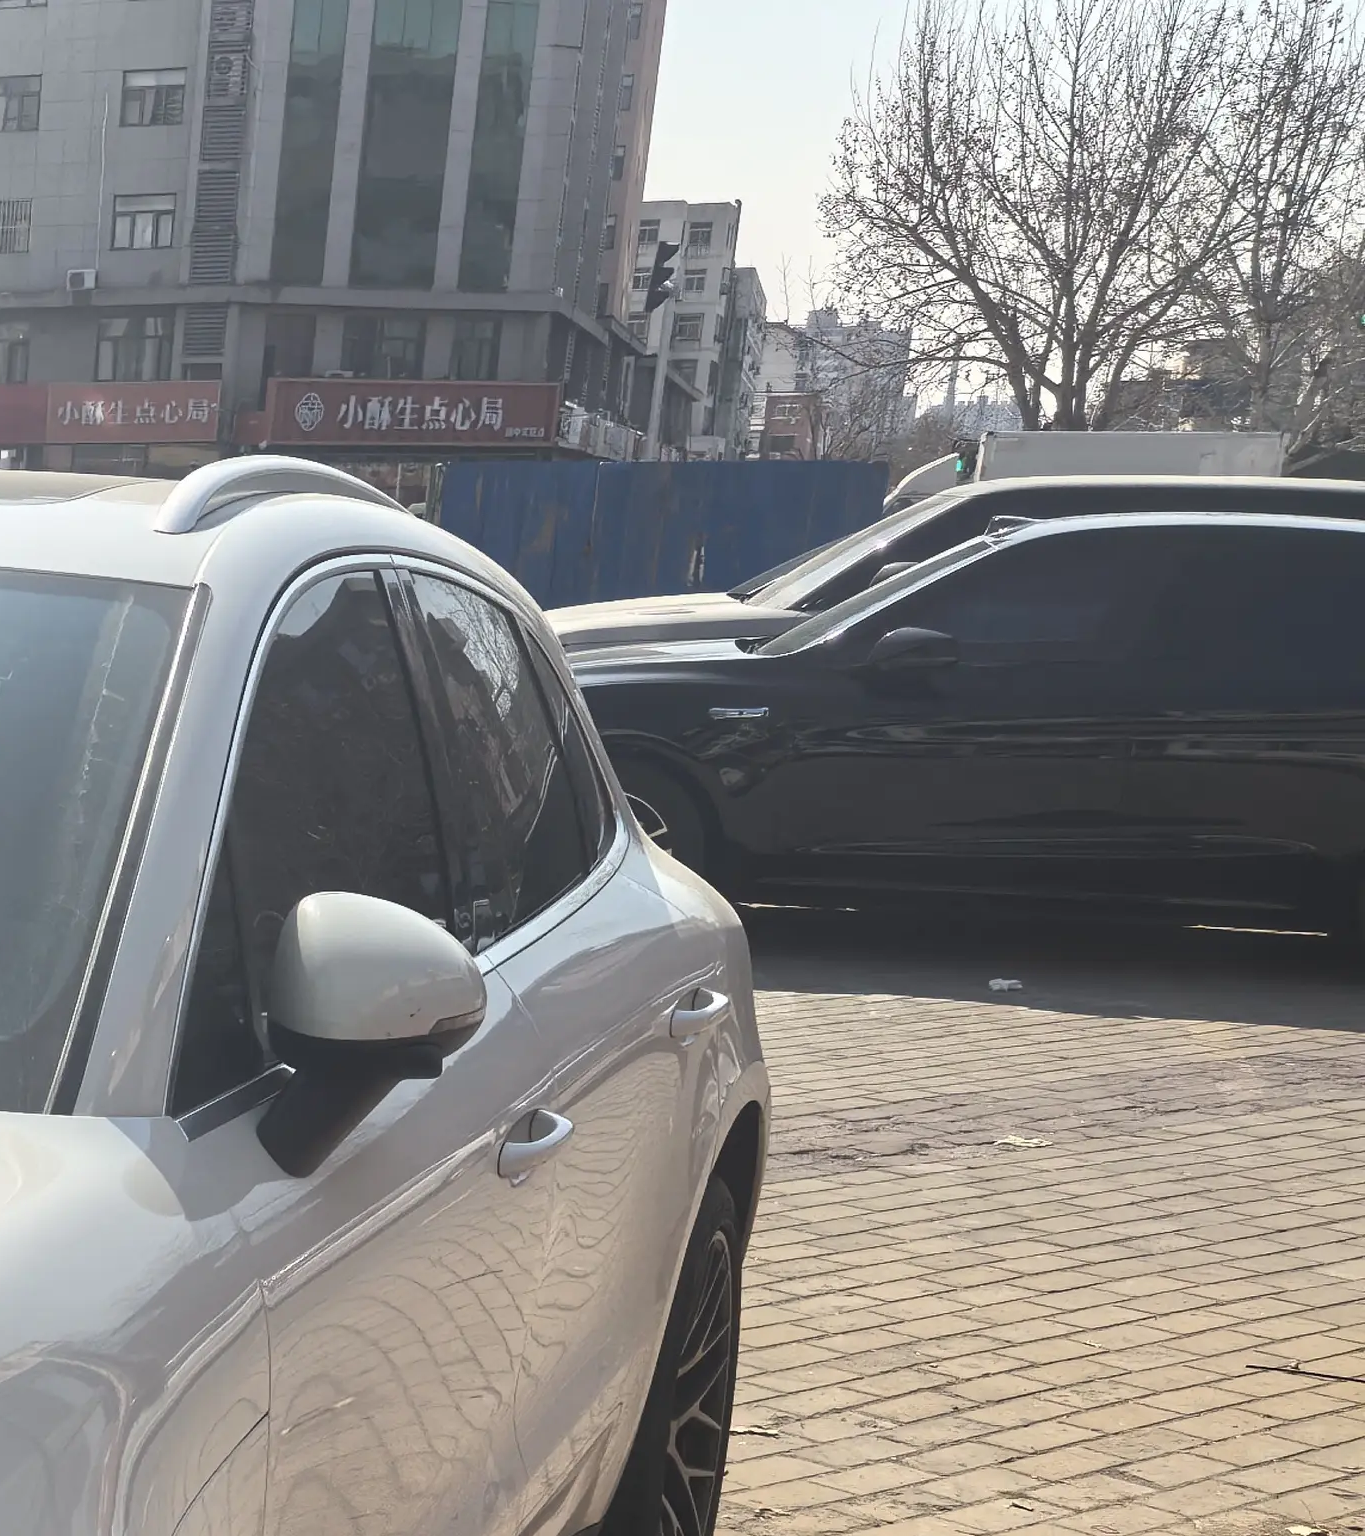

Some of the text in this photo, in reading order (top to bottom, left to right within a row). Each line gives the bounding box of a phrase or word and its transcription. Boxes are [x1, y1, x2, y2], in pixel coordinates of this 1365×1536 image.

[57, 398, 210, 426] 小酥生点心局
[337, 395, 503, 431] 小酥生点心局
